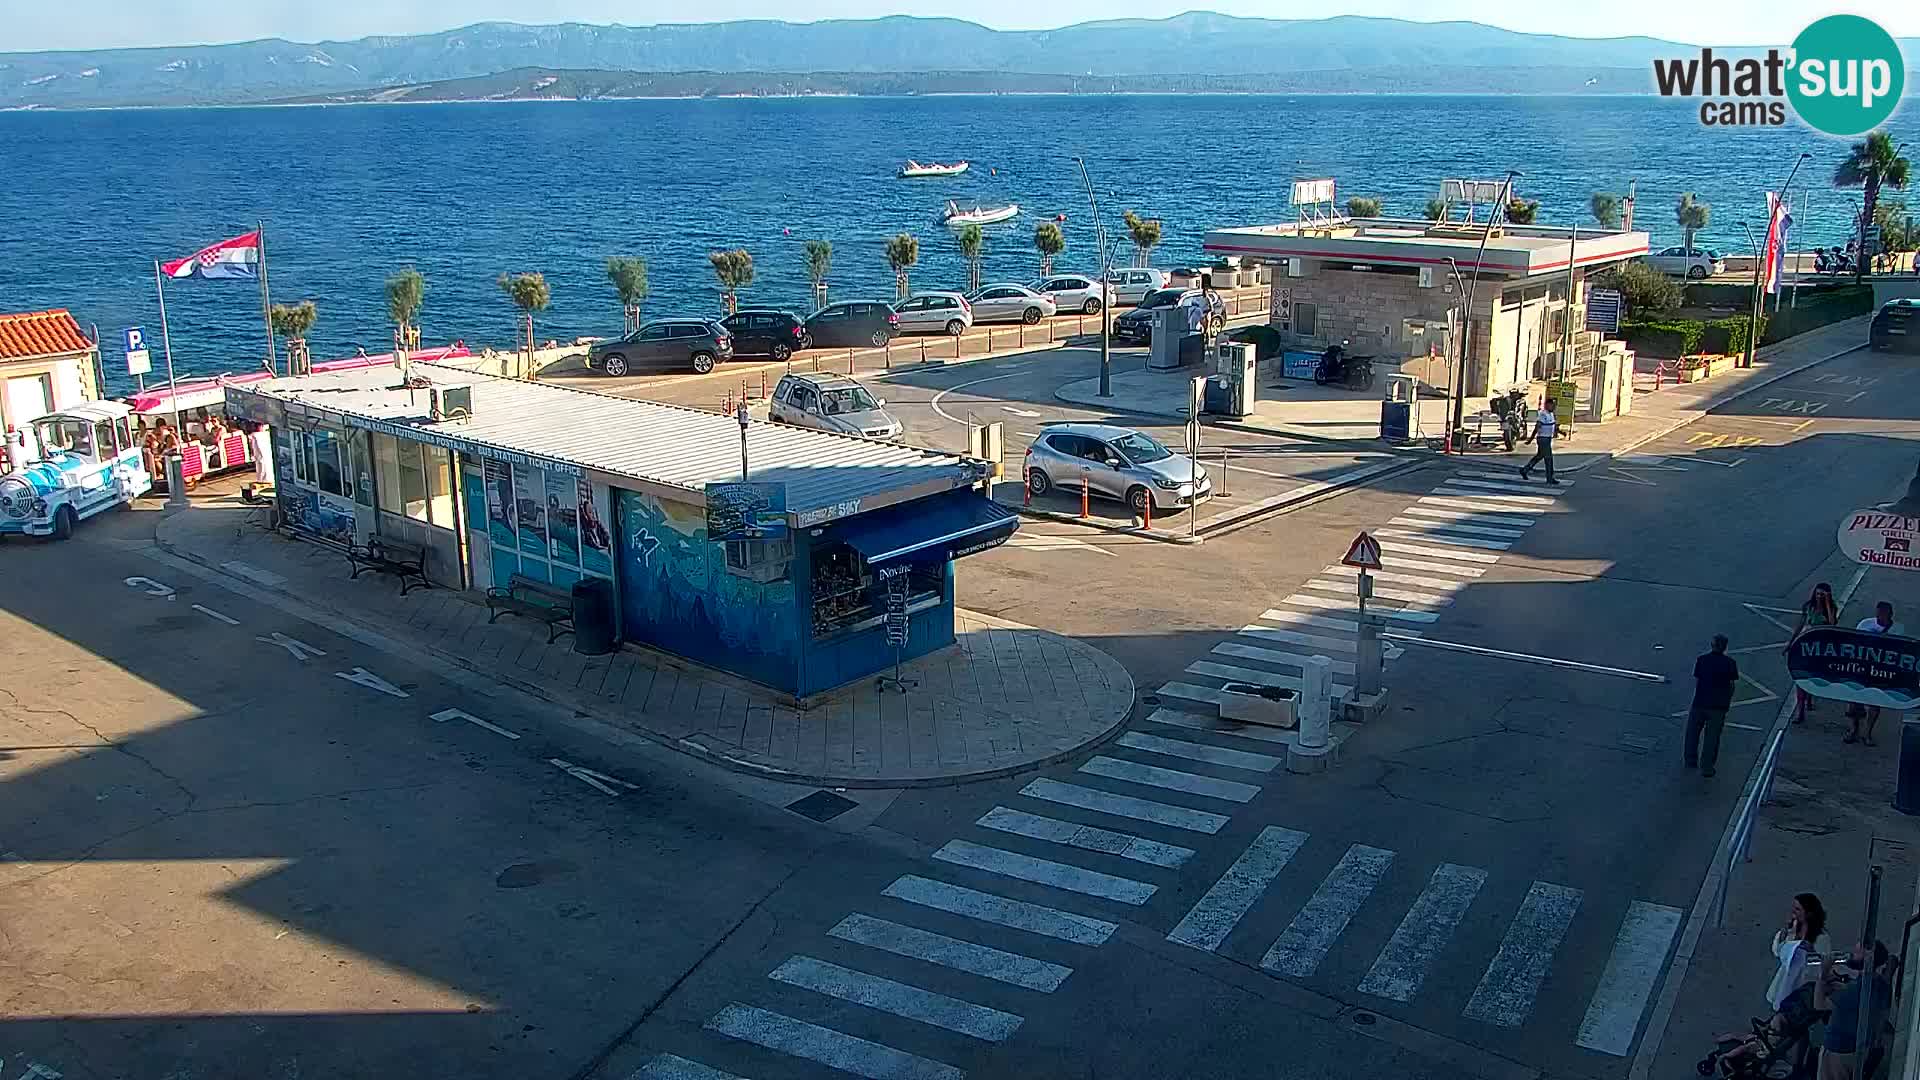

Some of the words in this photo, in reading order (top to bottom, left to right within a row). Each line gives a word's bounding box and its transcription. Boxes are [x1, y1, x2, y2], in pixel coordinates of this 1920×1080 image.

[128, 330, 143, 350] P
[1816, 373, 1879, 386] TAXI
[1759, 398, 1829, 414] TAXI
[1685, 431, 1766, 450] TAXI
[436, 436, 467, 453] POSTAJA
[477, 447, 492, 457] BUS
[493, 450, 526, 465] STATION
[528, 456, 554, 471] TICKET
[554, 462, 582, 477] OFFICE
[1848, 515, 1920, 533] PIZZE
[1870, 665, 1897, 680] bar
